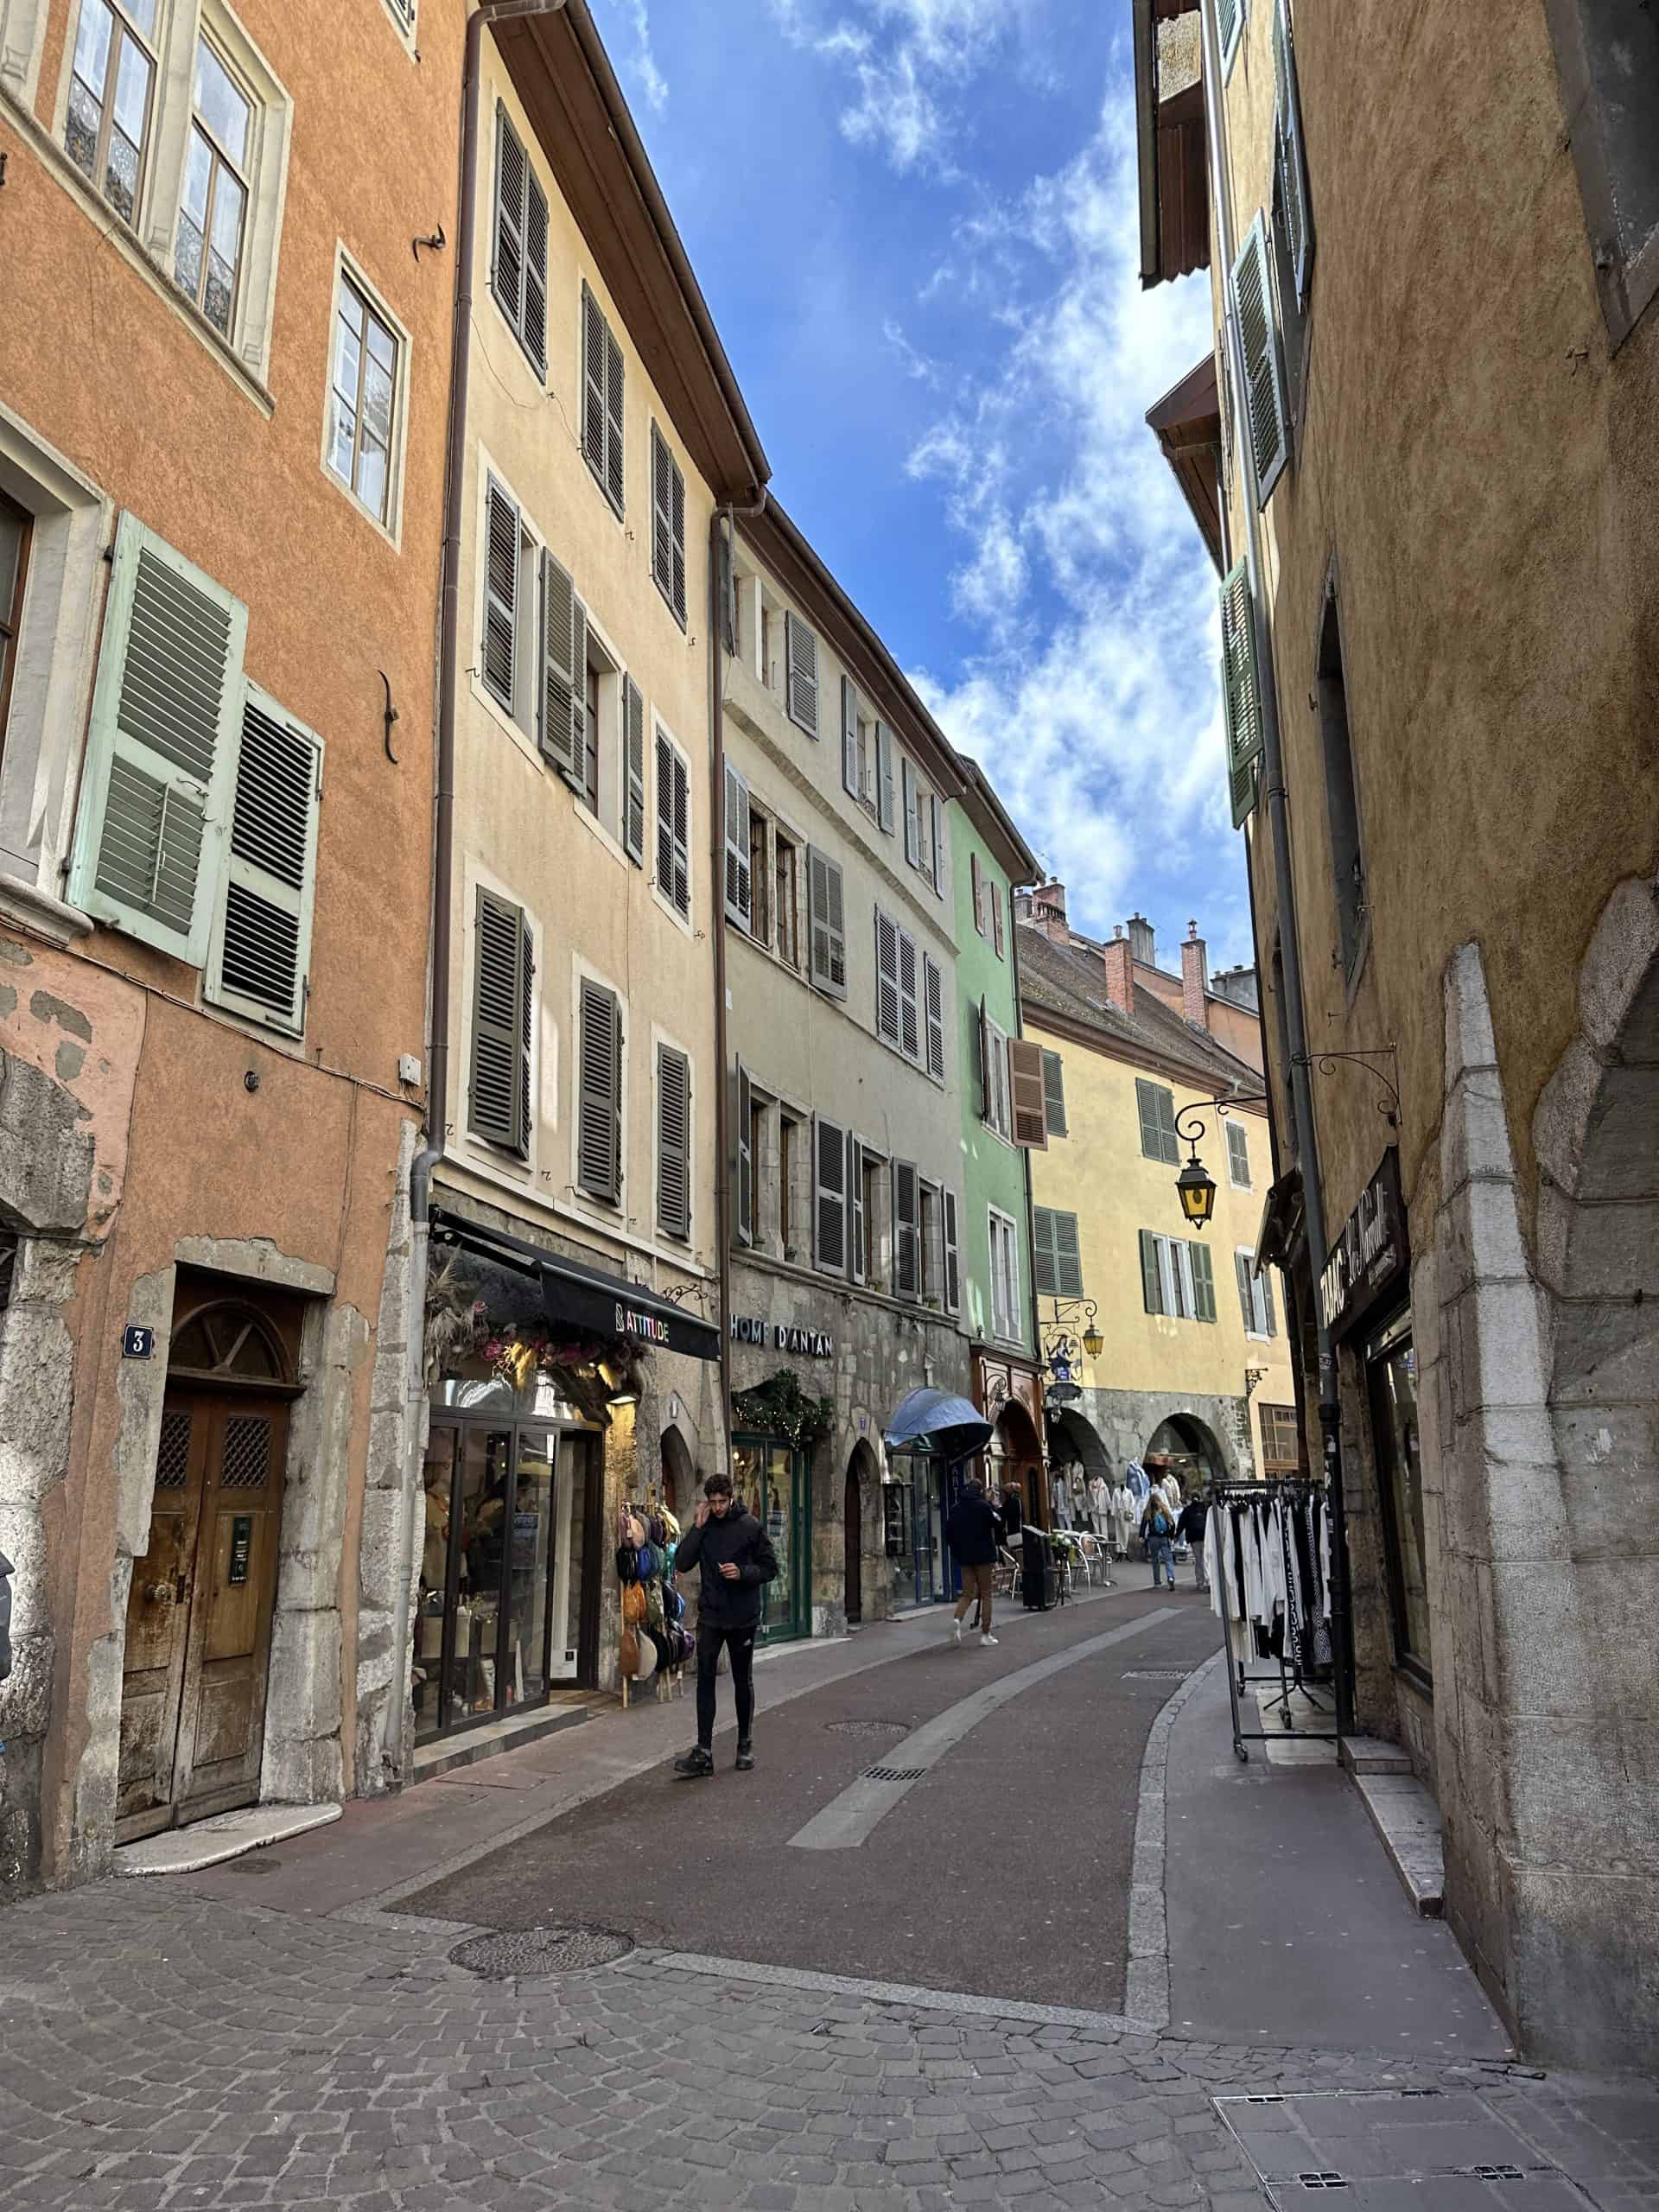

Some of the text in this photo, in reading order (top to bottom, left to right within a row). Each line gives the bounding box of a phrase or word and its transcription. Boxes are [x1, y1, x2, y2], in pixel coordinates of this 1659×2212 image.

[1320, 1248, 1344, 1329] TABAC
[133, 1331, 145, 1352] 3
[626, 1310, 670, 1343] ATTITUDE
[730, 1313, 769, 1344] HOME
